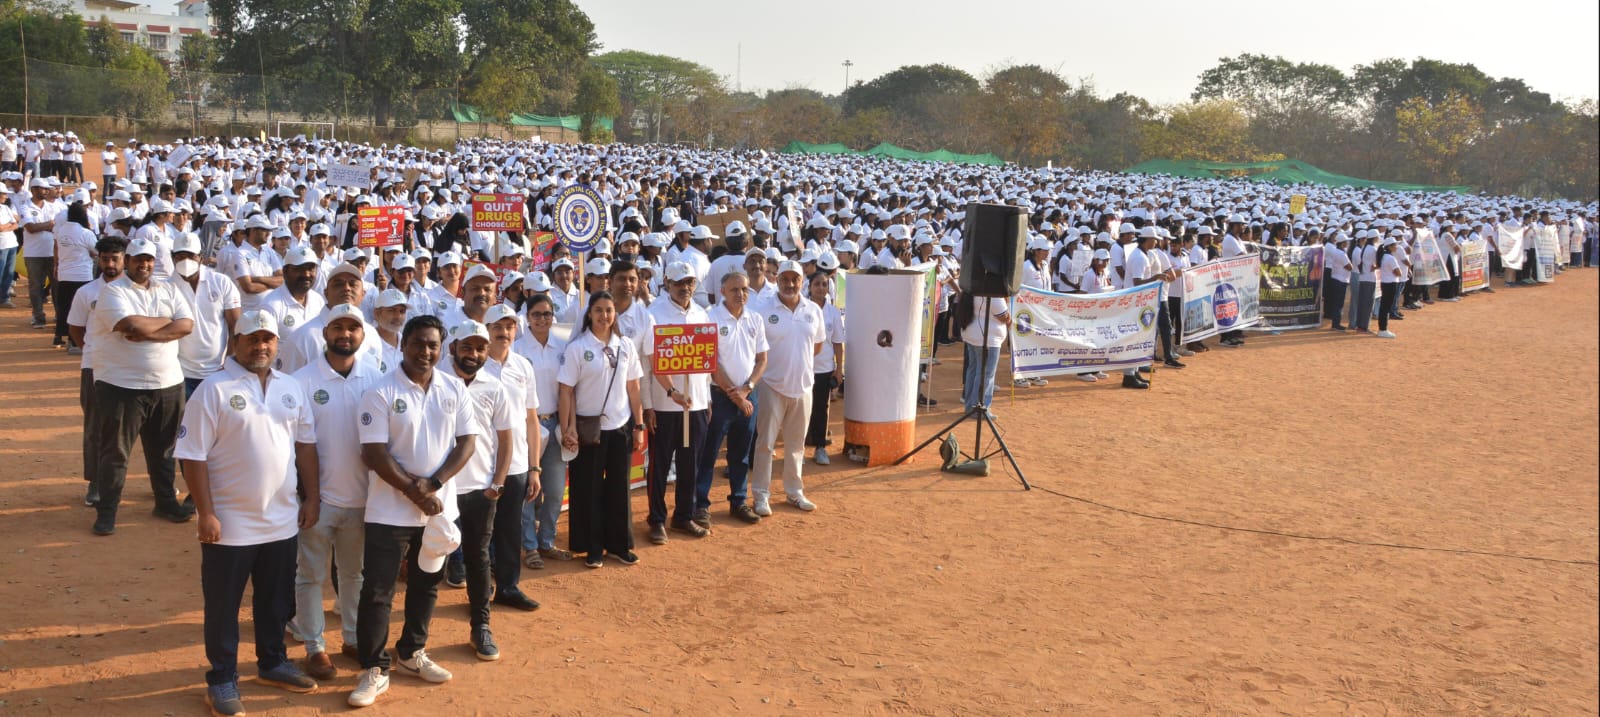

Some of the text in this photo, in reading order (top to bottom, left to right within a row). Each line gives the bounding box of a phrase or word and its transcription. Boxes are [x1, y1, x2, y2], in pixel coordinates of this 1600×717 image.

[564, 186, 584, 195] DENTAL
[585, 189, 604, 210] COLLEGE
[483, 202, 513, 212] QUIT
[475, 211, 521, 222] DRUGS
[505, 221, 521, 229] LIFE
[589, 220, 606, 246] HOSPITAL
[673, 335, 694, 345] SAY
[658, 343, 714, 358] TO NOPE
[658, 356, 703, 370] DOPE
